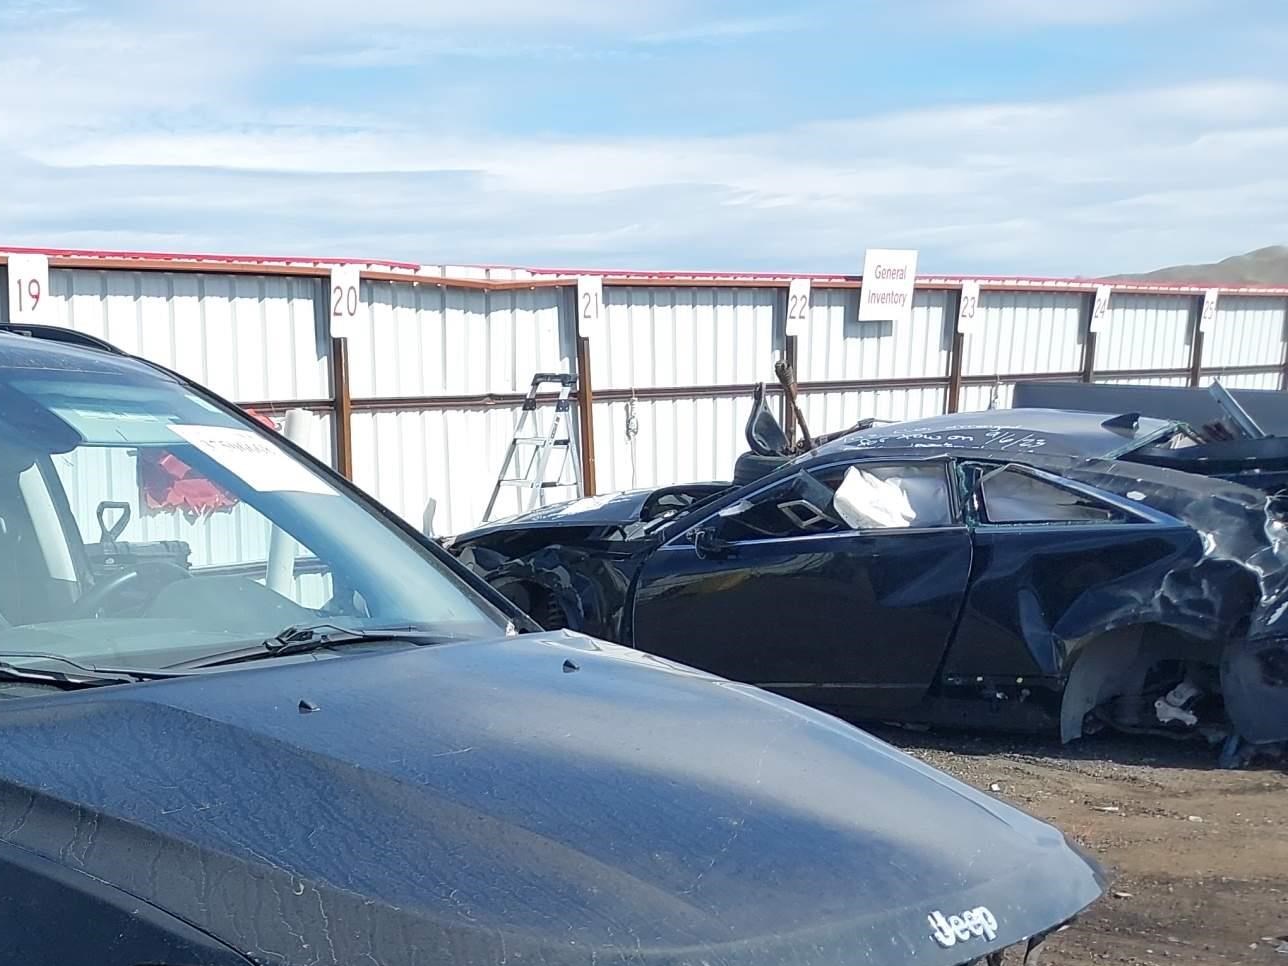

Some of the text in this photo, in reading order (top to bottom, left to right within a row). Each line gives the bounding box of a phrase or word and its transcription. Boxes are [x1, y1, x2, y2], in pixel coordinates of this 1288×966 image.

[874, 265, 907, 280] General
[16, 279, 40, 311] 19
[333, 286, 358, 316] 20
[583, 292, 600, 319] 21
[789, 295, 808, 319] 22
[867, 289, 907, 307] Inventory
[961, 296, 976, 318] 23
[1095, 298, 1108, 318] 24
[927, 906, 998, 946] Jeep
